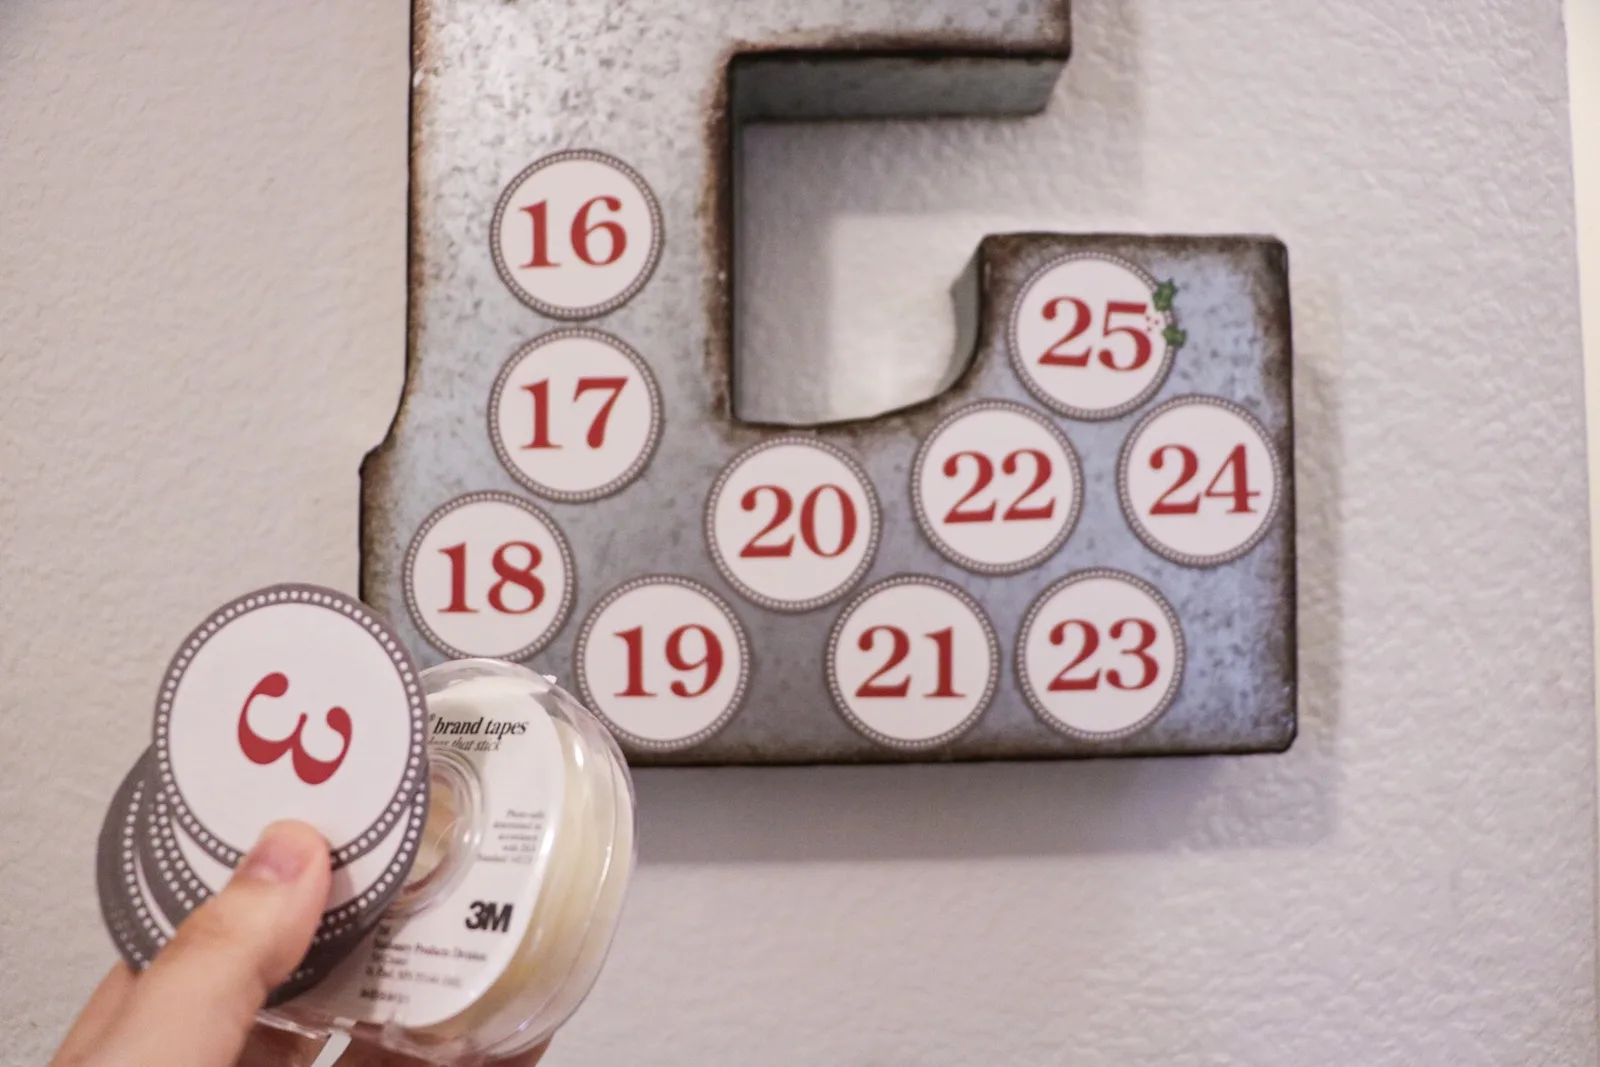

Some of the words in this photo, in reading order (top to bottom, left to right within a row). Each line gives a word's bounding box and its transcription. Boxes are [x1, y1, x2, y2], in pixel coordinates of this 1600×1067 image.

[519, 194, 628, 270] 16
[1037, 295, 1153, 373] 25
[520, 375, 630, 452] 17
[942, 448, 1057, 525] 22
[1147, 442, 1261, 518] 24
[738, 484, 859, 559] 20
[437, 540, 547, 616] 18
[613, 623, 726, 699] 19
[855, 624, 966, 700] 21
[1047, 618, 1161, 694] 23
[236, 671, 353, 786] 3
[432, 716, 485, 735] brand
[484, 718, 529, 740] tapes
[465, 901, 513, 933] 3M
